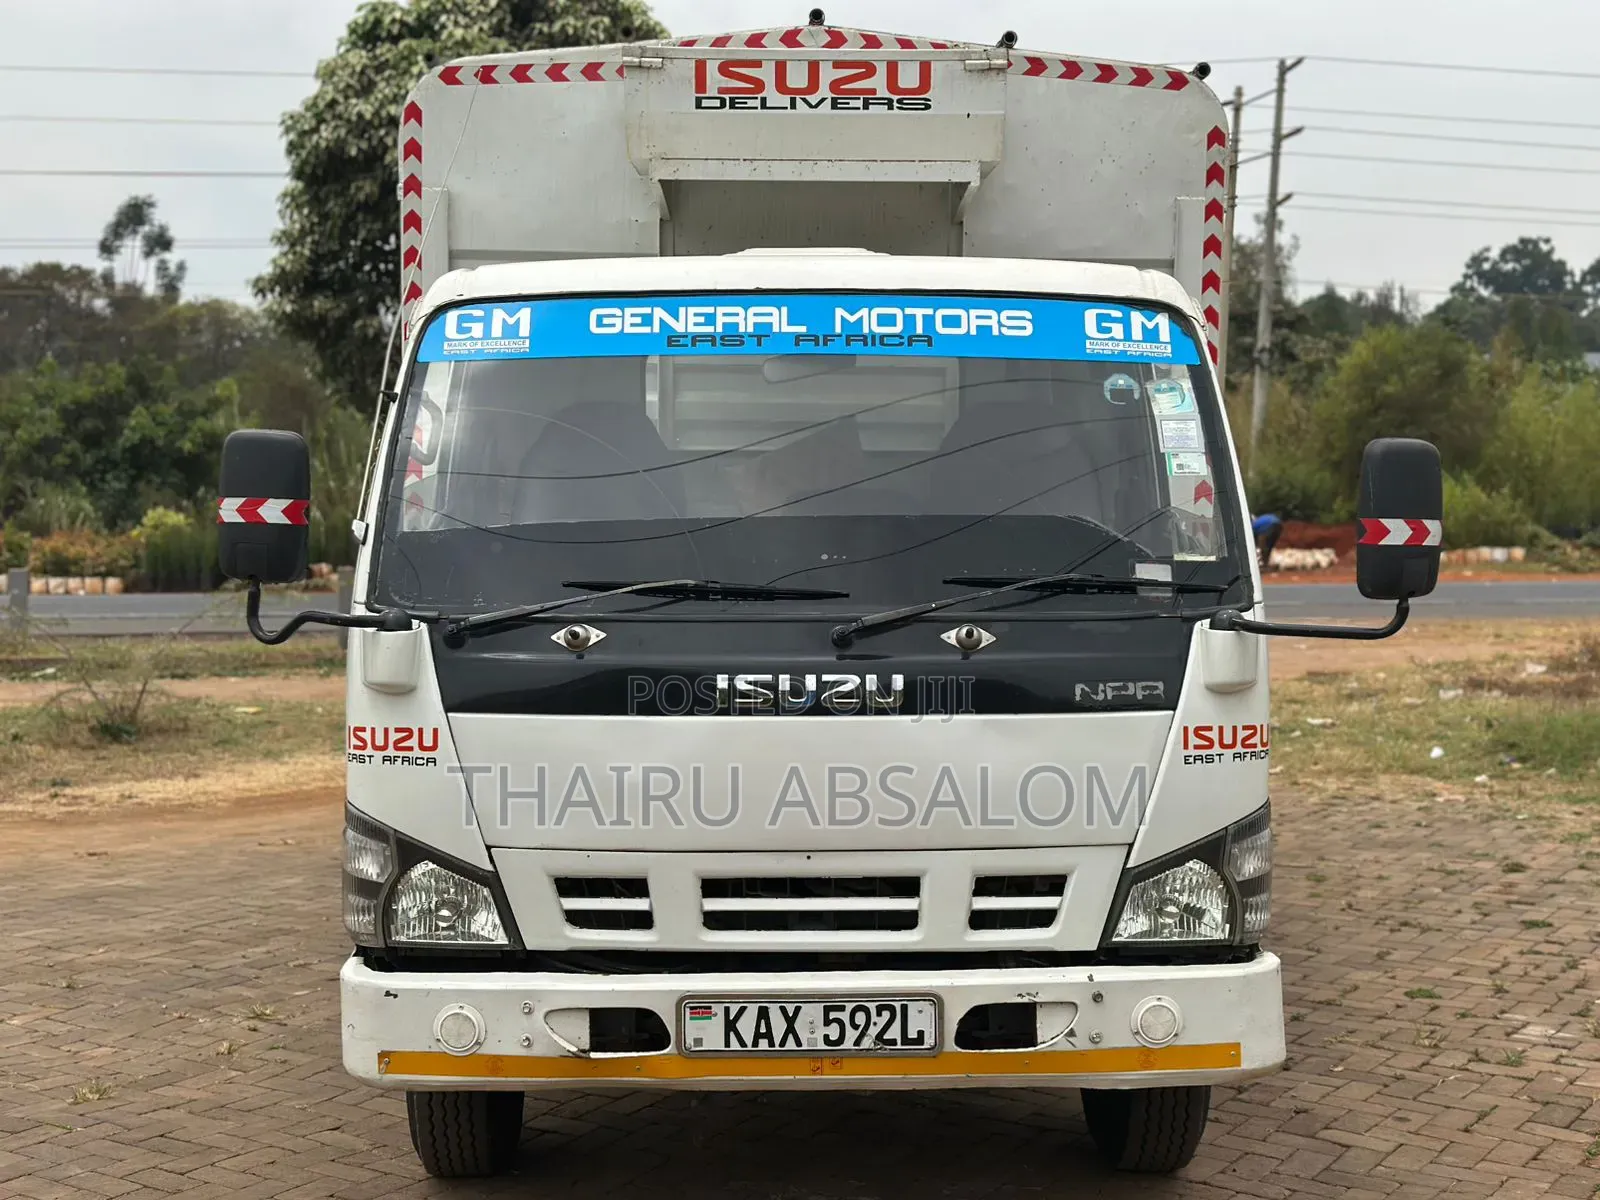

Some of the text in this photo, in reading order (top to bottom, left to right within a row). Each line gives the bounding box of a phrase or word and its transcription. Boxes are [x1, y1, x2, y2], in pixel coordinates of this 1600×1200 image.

[694, 59, 932, 96] ISUZU
[695, 96, 932, 111] DELIVERS
[444, 307, 531, 339] GM
[588, 306, 1034, 336] GENERAL MOTORS
[1084, 308, 1170, 342] GM
[481, 339, 527, 347] EXCELLENCE
[666, 334, 933, 348] EAST AFRICA
[1123, 342, 1169, 351] EXCELLENCE
[716, 674, 905, 708] ISUZU
[1074, 681, 1165, 702] NPR
[348, 725, 439, 752] ISUZU
[1183, 723, 1269, 750] ISUZU
[347, 753, 437, 767] EAST AFRICA
[1184, 753, 1225, 765] EAST
[723, 1005, 803, 1048] KAX
[823, 1003, 925, 1048] 592L
